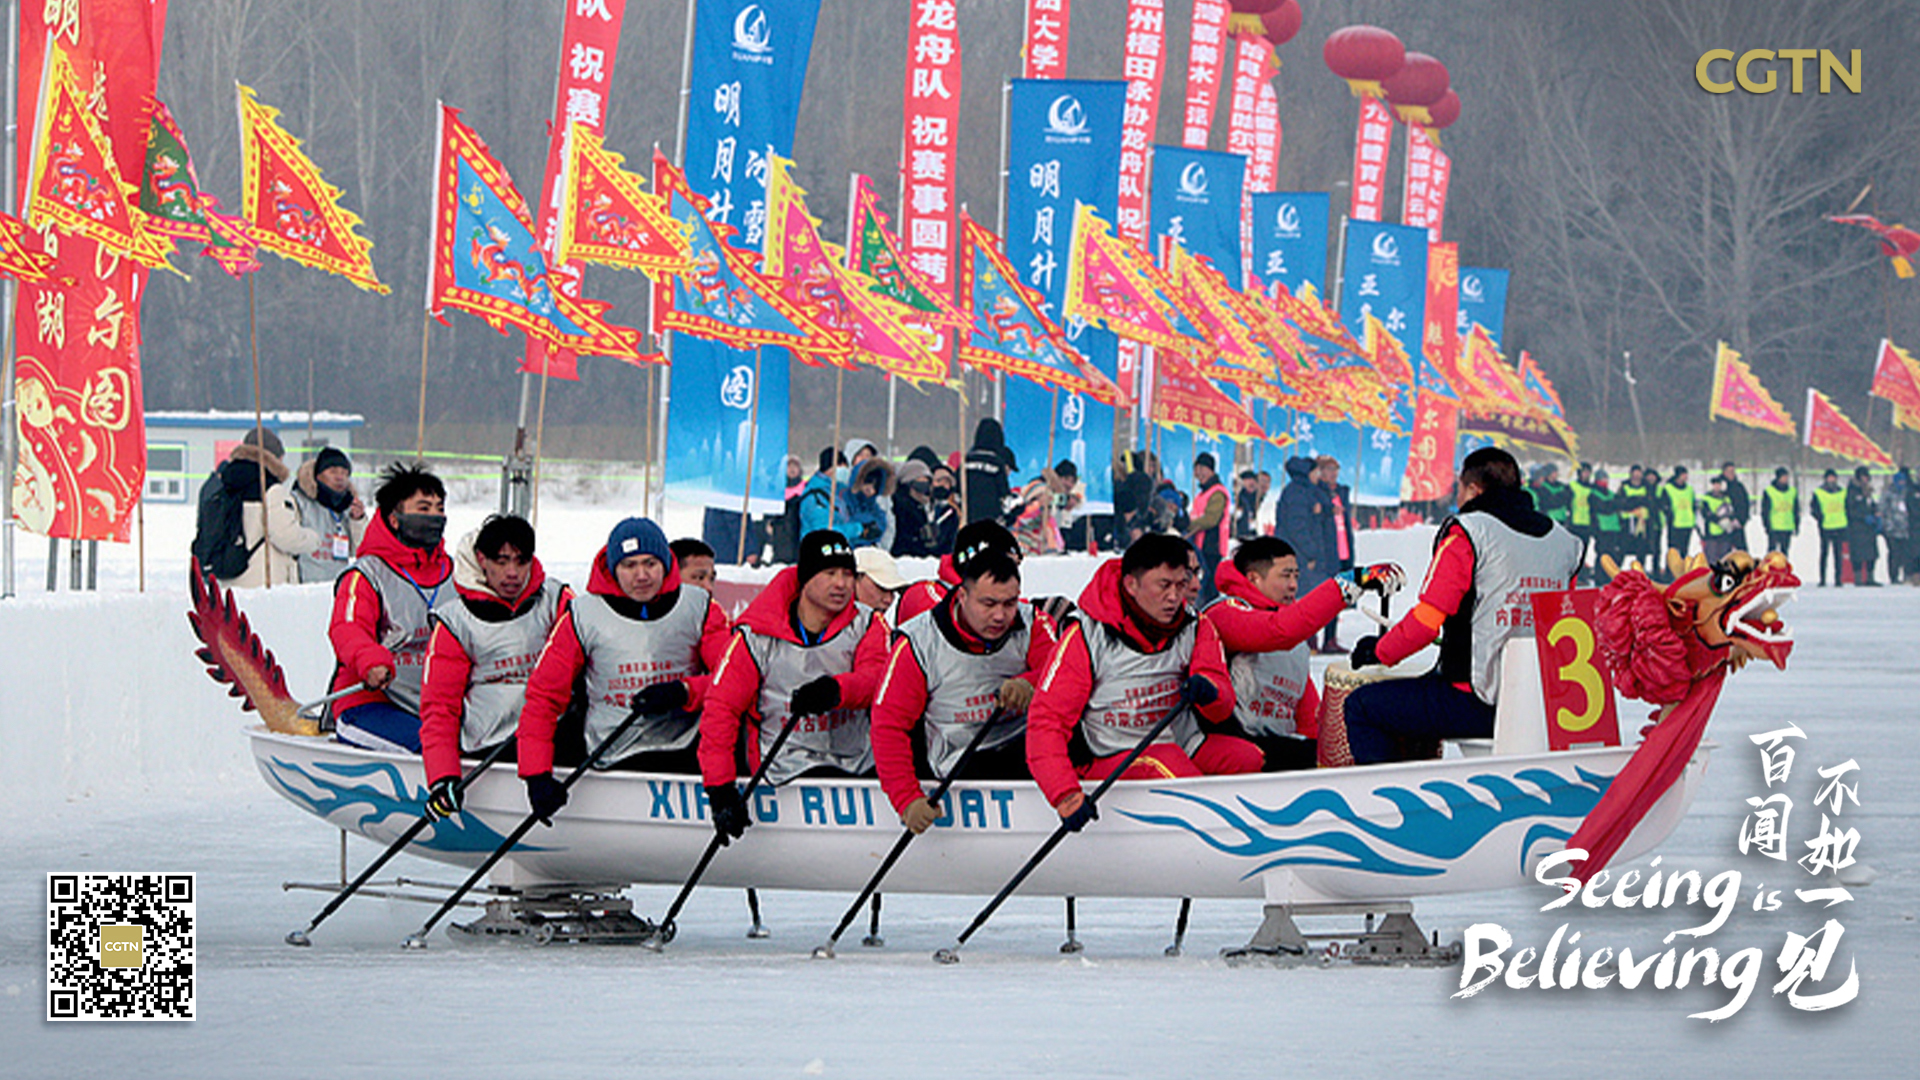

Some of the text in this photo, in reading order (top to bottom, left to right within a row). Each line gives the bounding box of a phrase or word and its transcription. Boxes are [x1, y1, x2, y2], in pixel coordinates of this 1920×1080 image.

[911, 0, 957, 99] 龙舟队
[1547, 616, 1605, 732] 3
[648, 780, 1014, 829] XIAG RUI OAT
